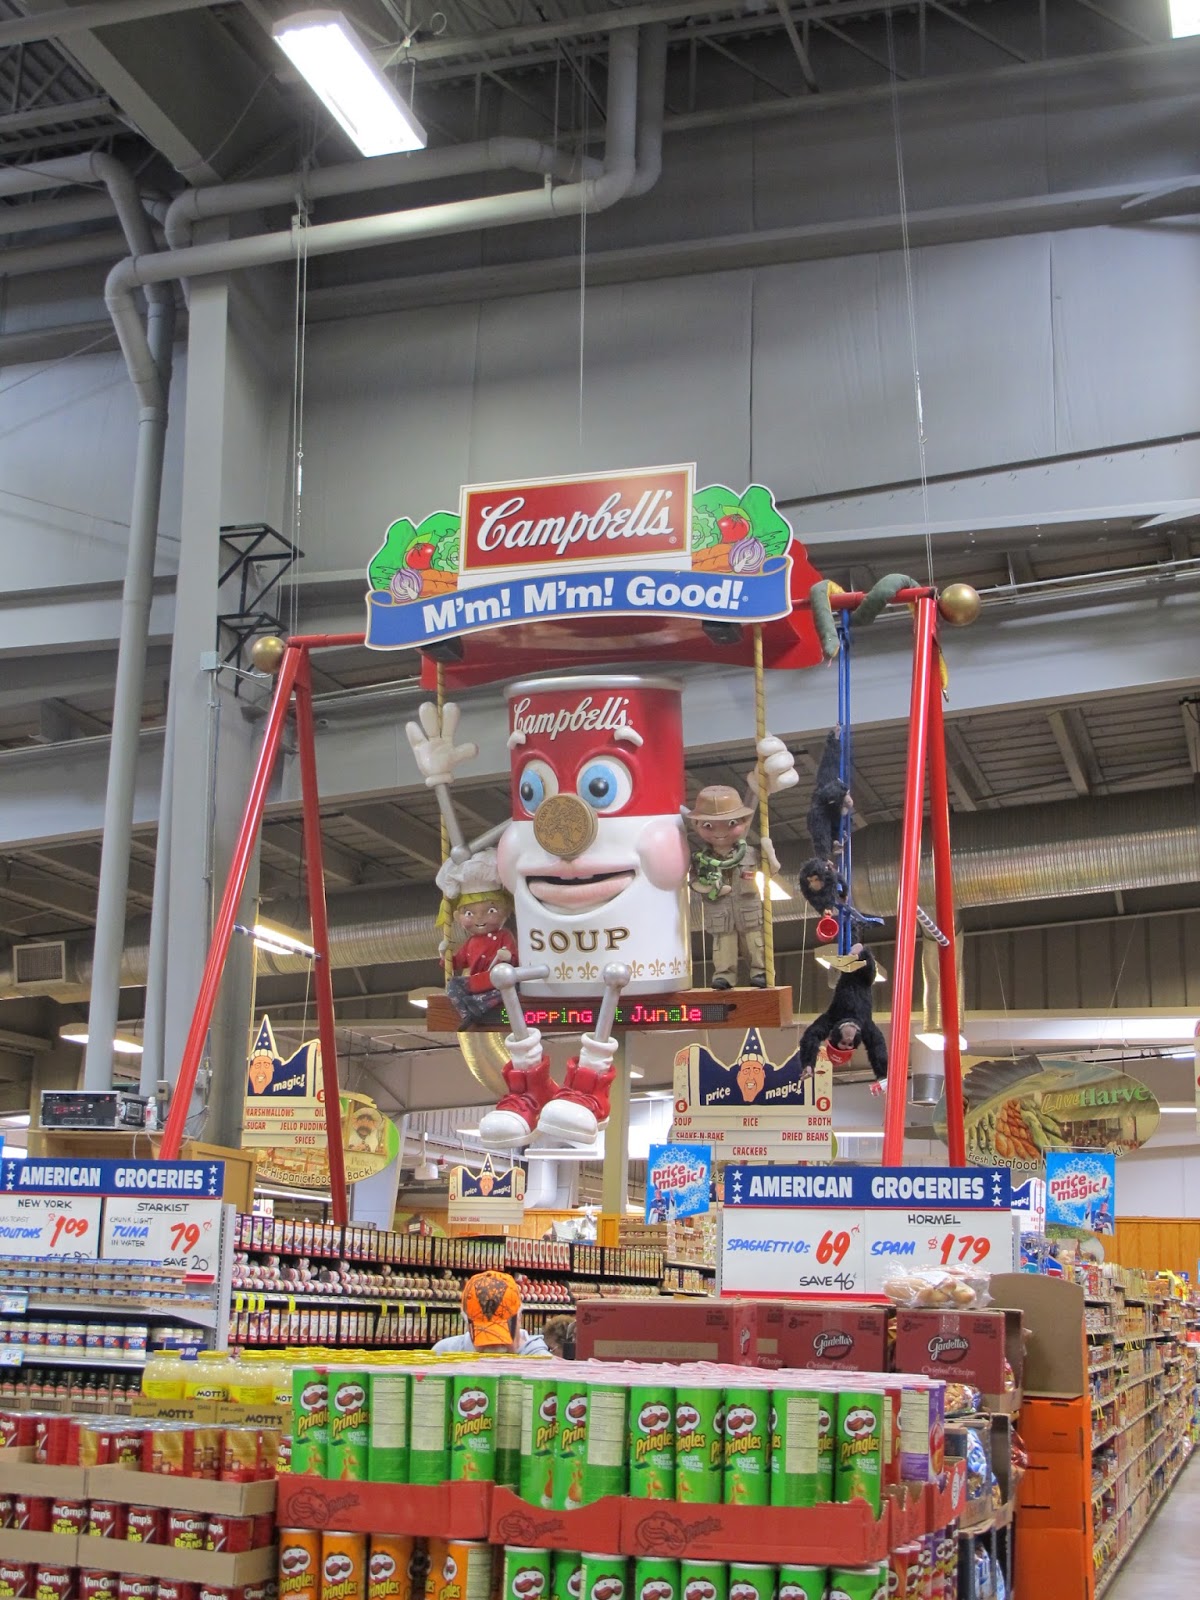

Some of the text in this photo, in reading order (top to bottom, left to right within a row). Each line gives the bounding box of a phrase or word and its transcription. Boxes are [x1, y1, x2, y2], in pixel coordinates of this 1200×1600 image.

[476, 488, 674, 555] Campbell's
[422, 576, 744, 634] M'm! M'm! Good!
[513, 696, 630, 740] Campbell's
[529, 926, 631, 955] SOUP
[501, 1005, 593, 1024] Sopping
[630, 1004, 702, 1023] Jungle
[273, 1074, 306, 1093] magic!
[765, 1080, 803, 1100] magic!
[1078, 1084, 1154, 1108] Harve
[314, 1109, 325, 1118] OIL
[246, 1121, 266, 1131] SUGAR
[280, 1121, 297, 1131] JELLO
[674, 1117, 831, 1127] SOUP RICE BROTH
[294, 1136, 315, 1145] SPICES
[782, 1132, 803, 1141] DRIED
[806, 1132, 829, 1141] BEANS
[732, 1146, 768, 1156] CRACKERS
[968, 1151, 989, 1165] Fresh
[991, 1155, 1038, 1173] Seafood
[19, 1166, 204, 1190] AMERICAN GROCERIES
[270, 1168, 308, 1184] Hispanic
[347, 1166, 373, 1181] Back!
[658, 1166, 705, 1190] magic!
[749, 1175, 853, 1198] AMERICAN
[871, 1177, 984, 1200] GROCERIES
[1057, 1176, 1108, 1203] magic!
[18, 1198, 72, 1209] NEW YORK
[136, 1202, 190, 1212] STARKIST
[133, 1217, 153, 1225] LIGHT
[907, 1214, 961, 1225] HORMEL
[0, 1226, 43, 1239] ROUTONS
[112, 1225, 149, 1239] TUNA
[870, 1241, 916, 1256] SPAM
[163, 1257, 188, 1267] SAVE
[799, 1275, 832, 1287] SAVE
[275, 1394, 292, 1402] MOT
[157, 1408, 194, 1419] MOTT'S
[245, 1414, 283, 1425] MOTT'S
[454, 1414, 492, 1442] Pringles
[841, 1434, 880, 1460] Pringles
[174, 1538, 203, 1550] BEANS
